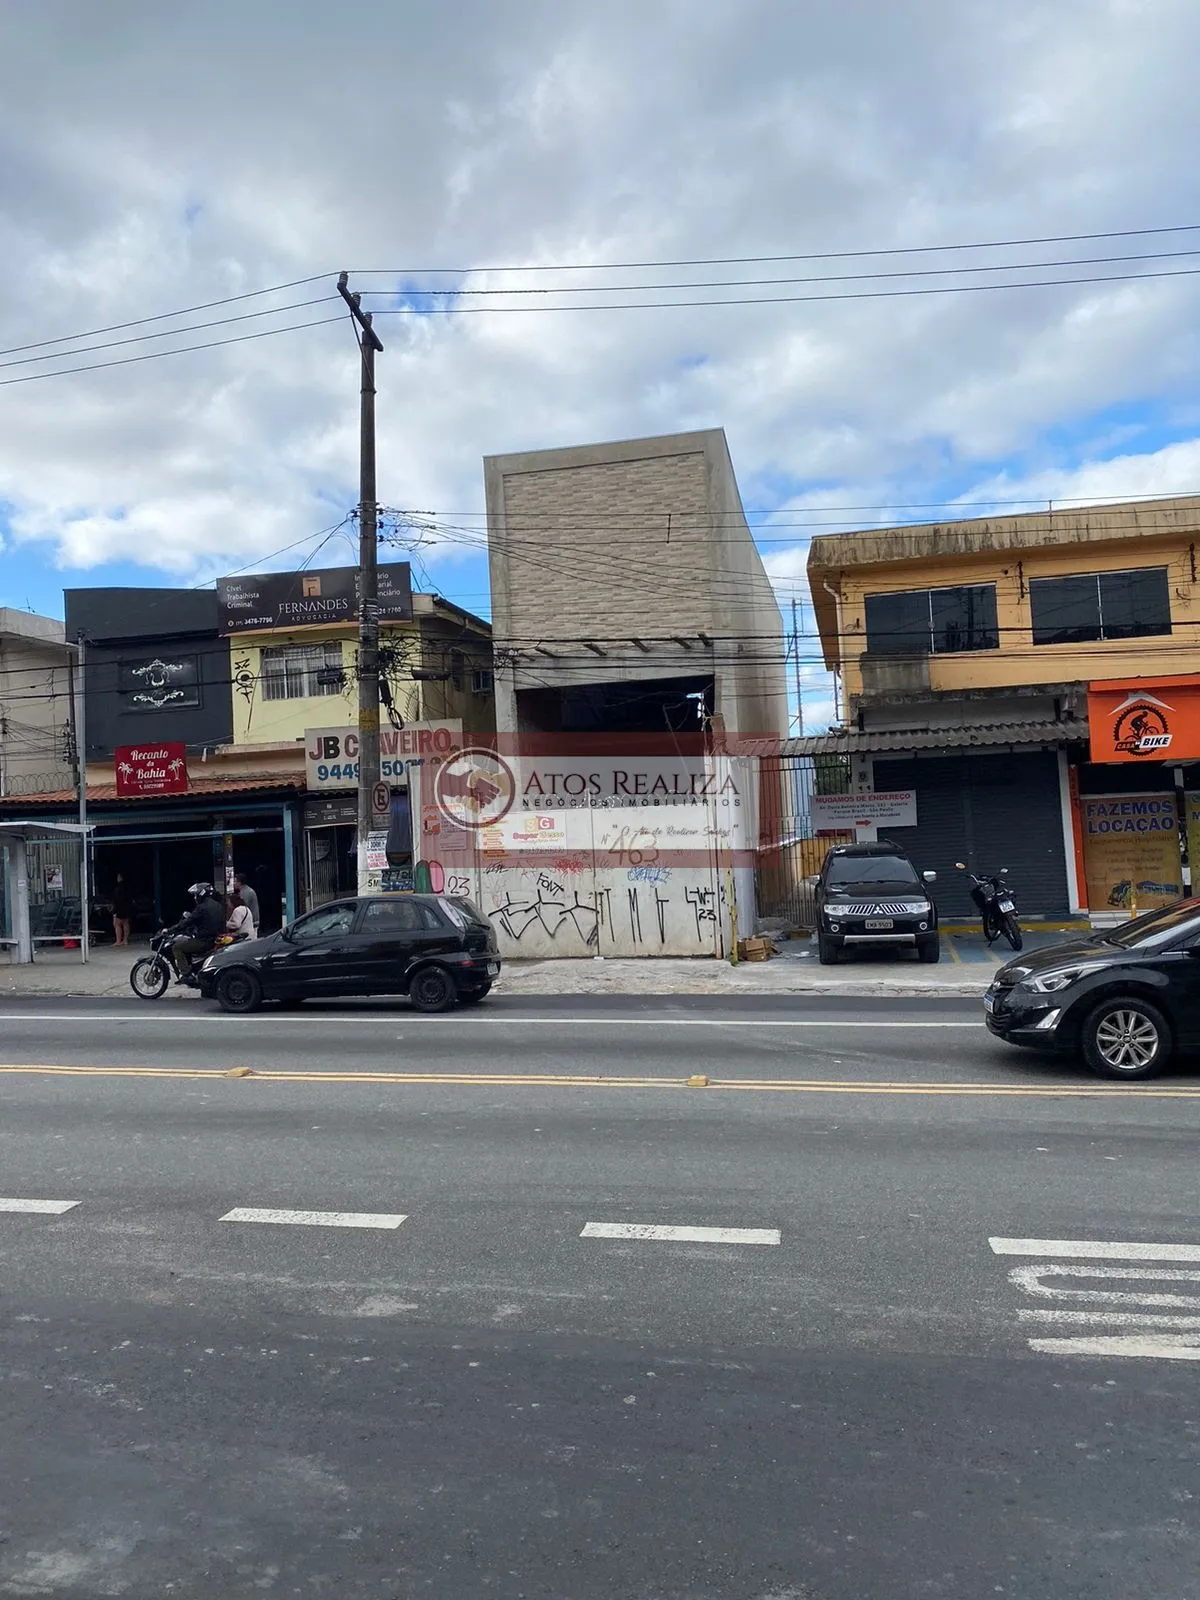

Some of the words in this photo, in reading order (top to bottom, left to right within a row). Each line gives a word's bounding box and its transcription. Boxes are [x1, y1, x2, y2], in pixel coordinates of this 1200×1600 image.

[226, 592, 260, 600] Trabalhista
[226, 600, 253, 609] Criminal
[278, 598, 349, 614] FERNANDES
[308, 736, 341, 760] JB
[344, 727, 452, 758] CAVEIRO
[1142, 736, 1170, 747] BIKE
[130, 749, 169, 761] Recanto
[136, 767, 166, 779] Bahia
[815, 796, 855, 804] MUDAMOS
[868, 793, 911, 801] ENDEREÇO
[1086, 800, 1173, 817] FAZEMOS
[1087, 814, 1175, 835] LOCAÇÃO
